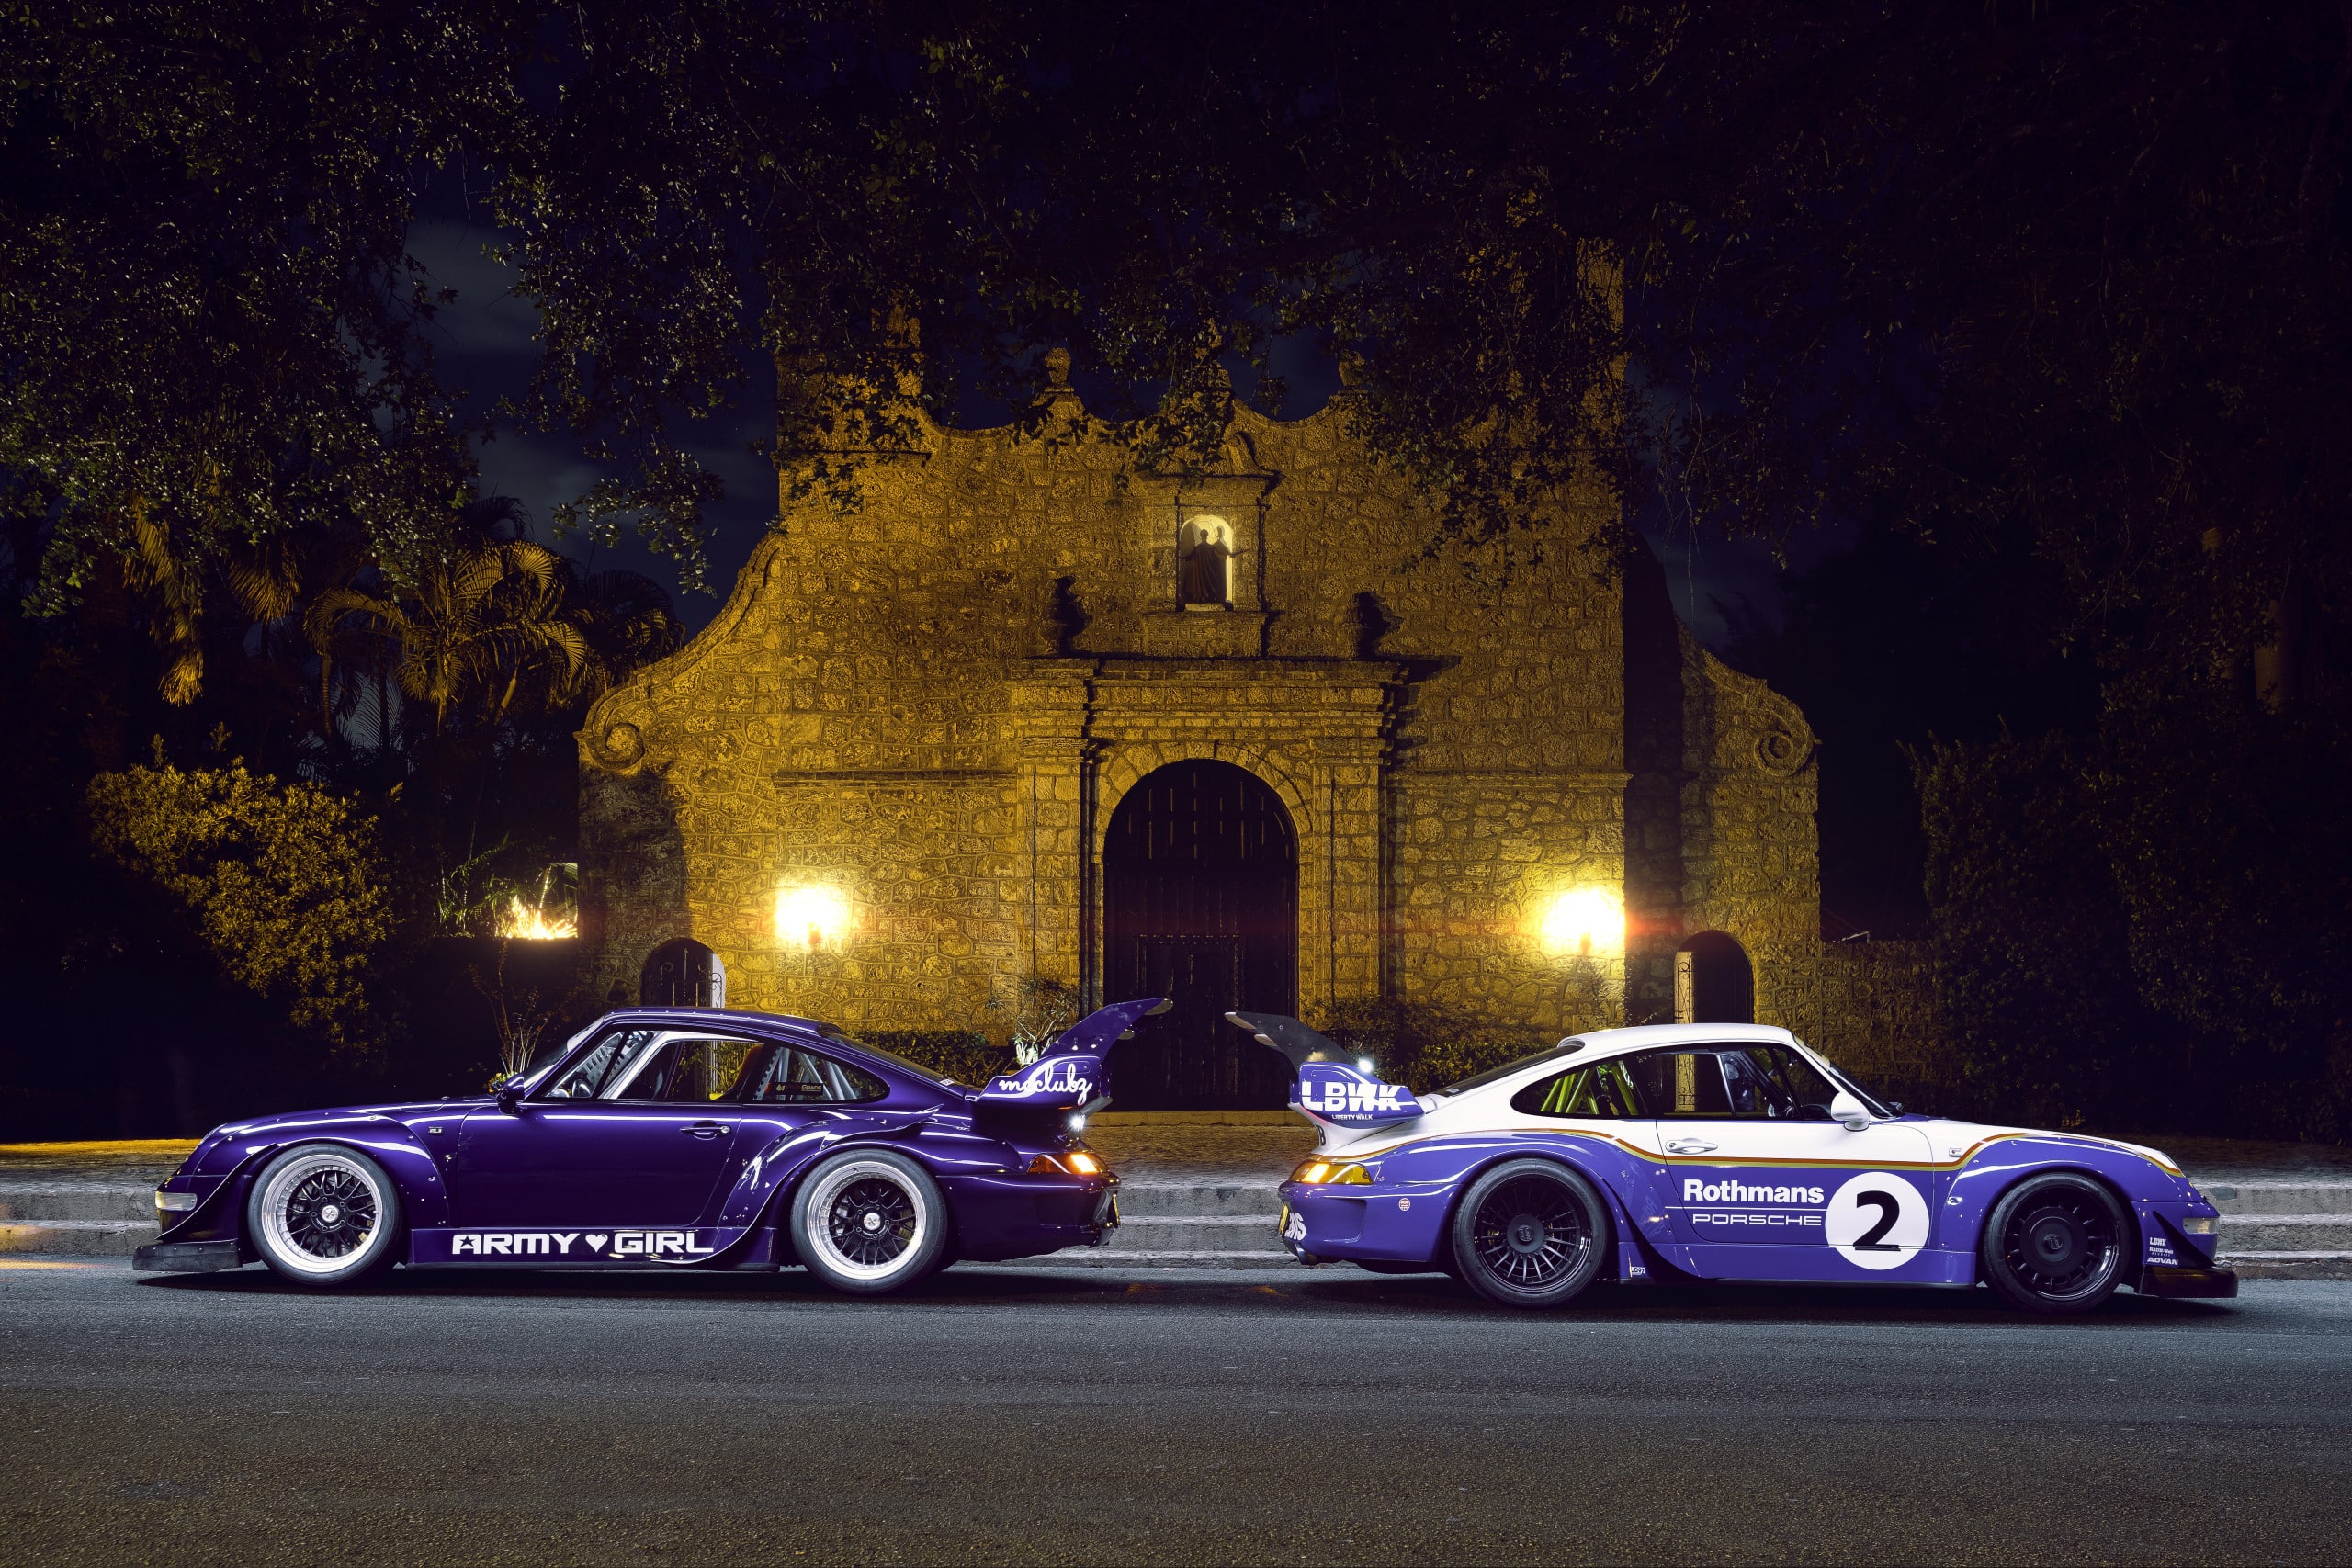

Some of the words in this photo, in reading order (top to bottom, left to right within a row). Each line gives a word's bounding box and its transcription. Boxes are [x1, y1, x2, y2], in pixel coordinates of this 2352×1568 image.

[1301, 1081, 1401, 1111] LBWK
[1683, 1179, 1825, 1205] Rothmans
[1692, 1213, 1822, 1226] PORSCHE
[1852, 1190, 1902, 1252] 2
[452, 1233, 580, 1255] ARMY
[614, 1232, 714, 1254] GIRL
[2147, 1257, 2178, 1265] ADVAN
